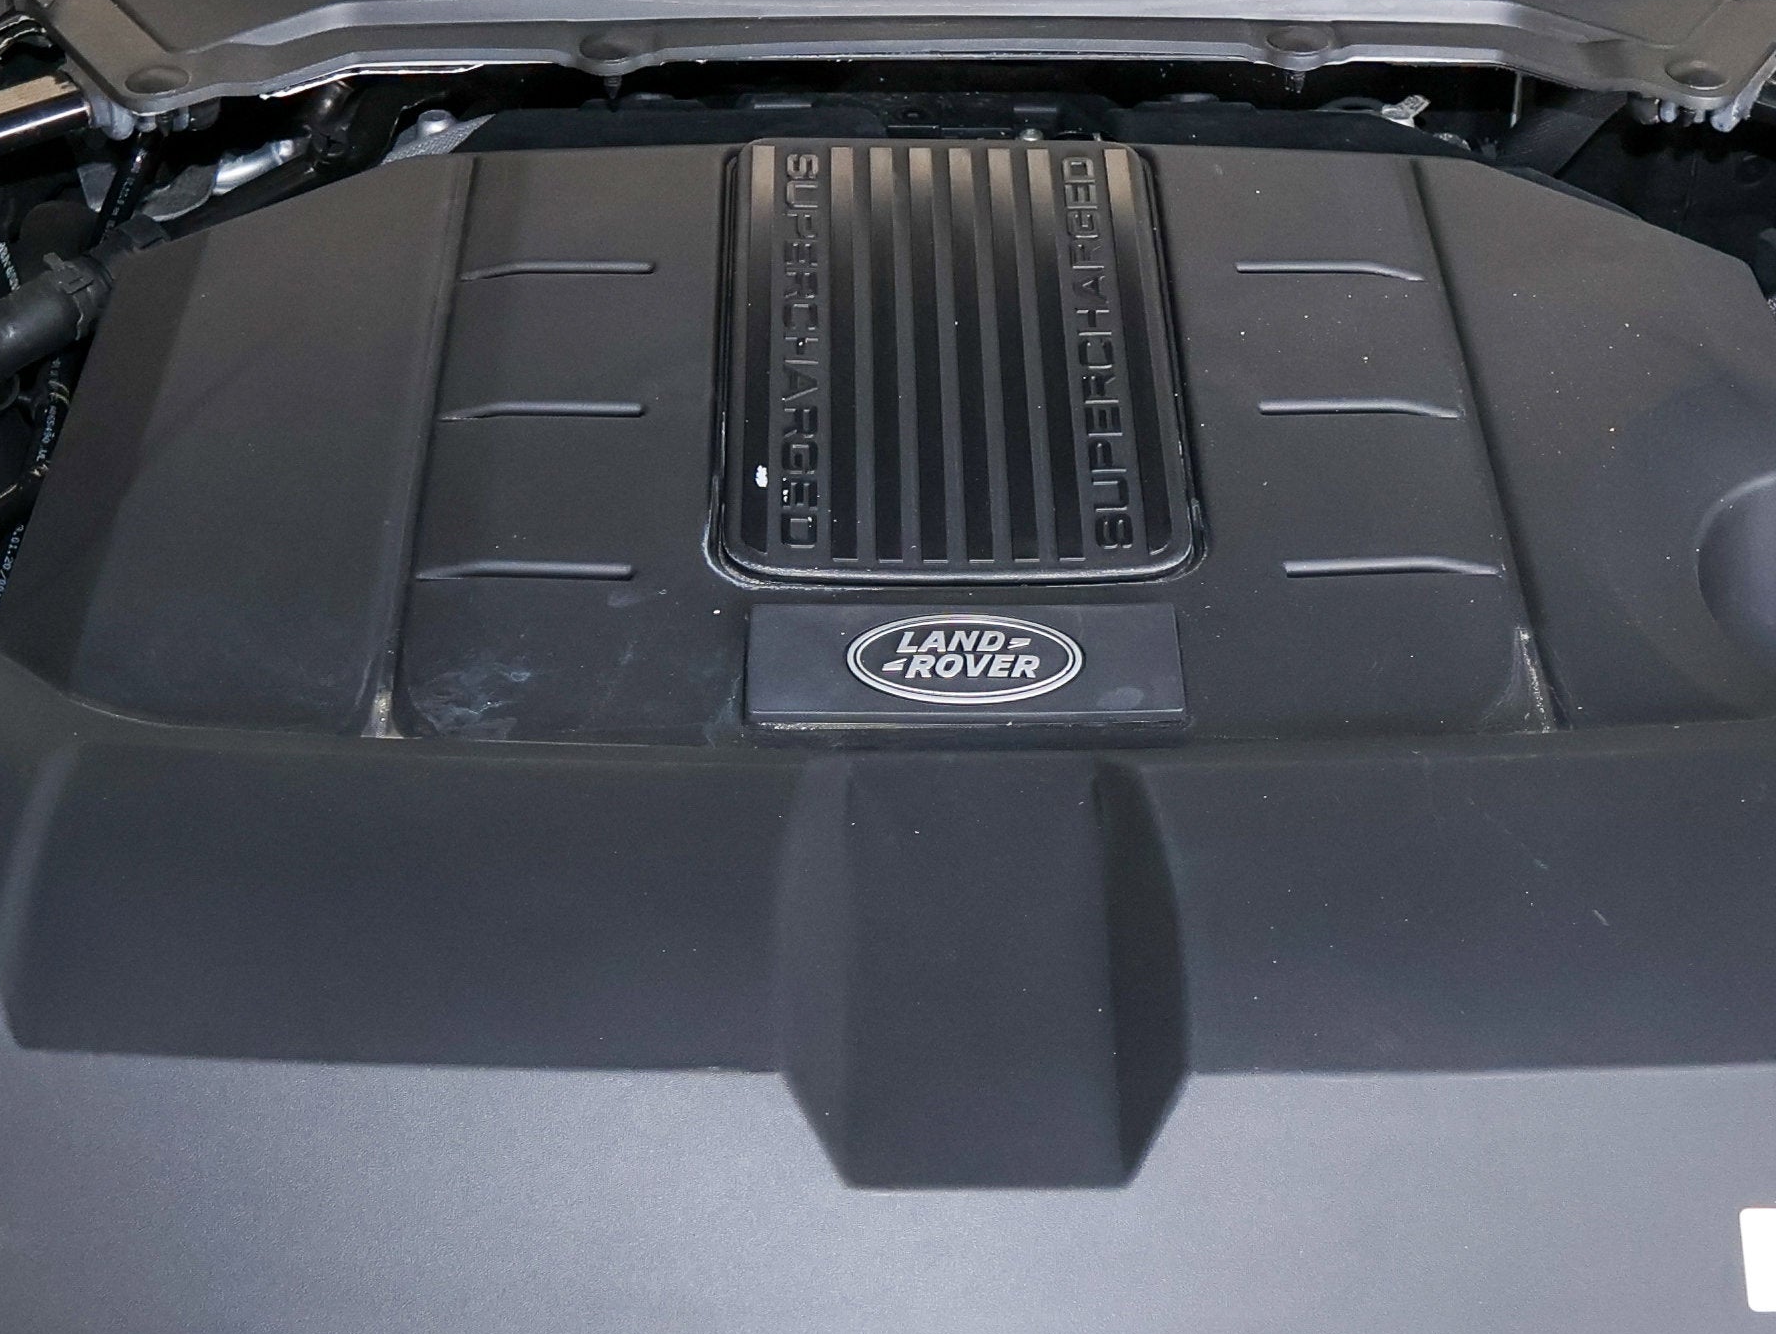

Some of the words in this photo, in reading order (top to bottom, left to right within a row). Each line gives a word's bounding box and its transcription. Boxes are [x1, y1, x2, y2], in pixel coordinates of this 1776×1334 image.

[780, 152, 821, 550] SUPERCHARGED
[1059, 155, 1135, 552] SUPERCHARGED
[896, 630, 1007, 655] LAND
[904, 653, 1042, 680] ROVER
